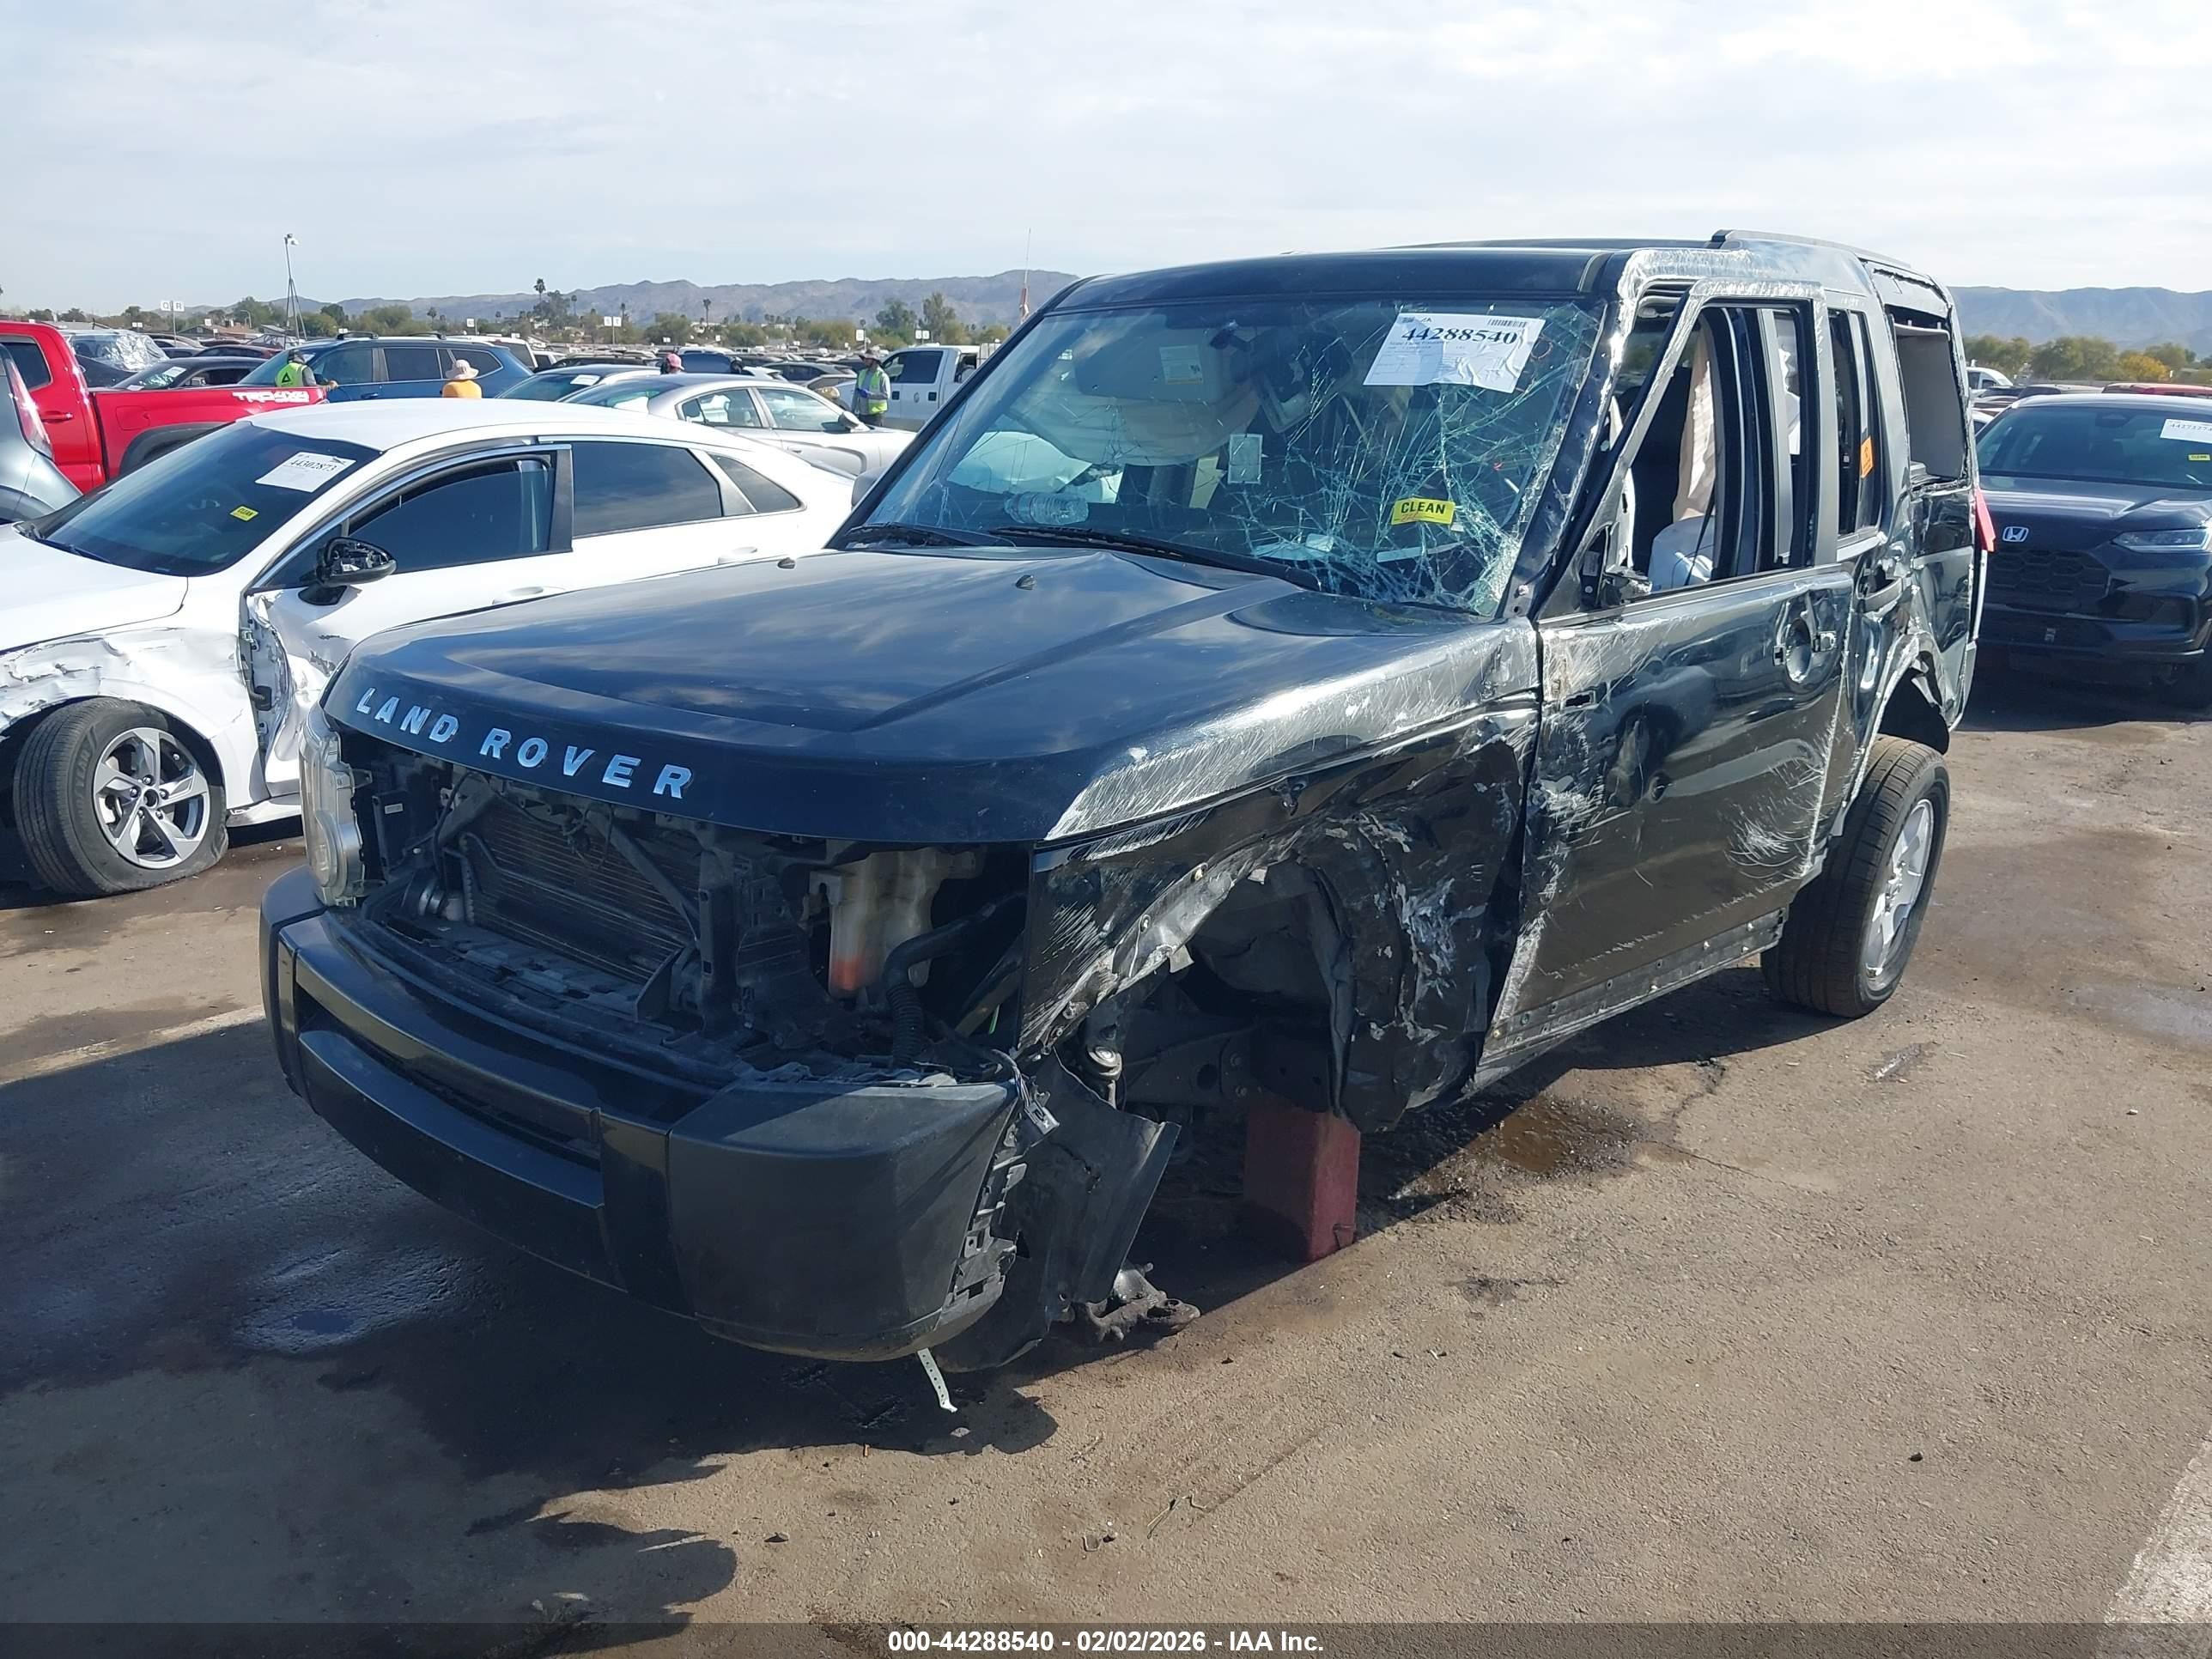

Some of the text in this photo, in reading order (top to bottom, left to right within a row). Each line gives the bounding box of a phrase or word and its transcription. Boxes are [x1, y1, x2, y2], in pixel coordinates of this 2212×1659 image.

[1401, 326, 1517, 344] 44288540
[1401, 501, 1446, 514] CLEAN
[356, 687, 693, 799] LAND ROVER
